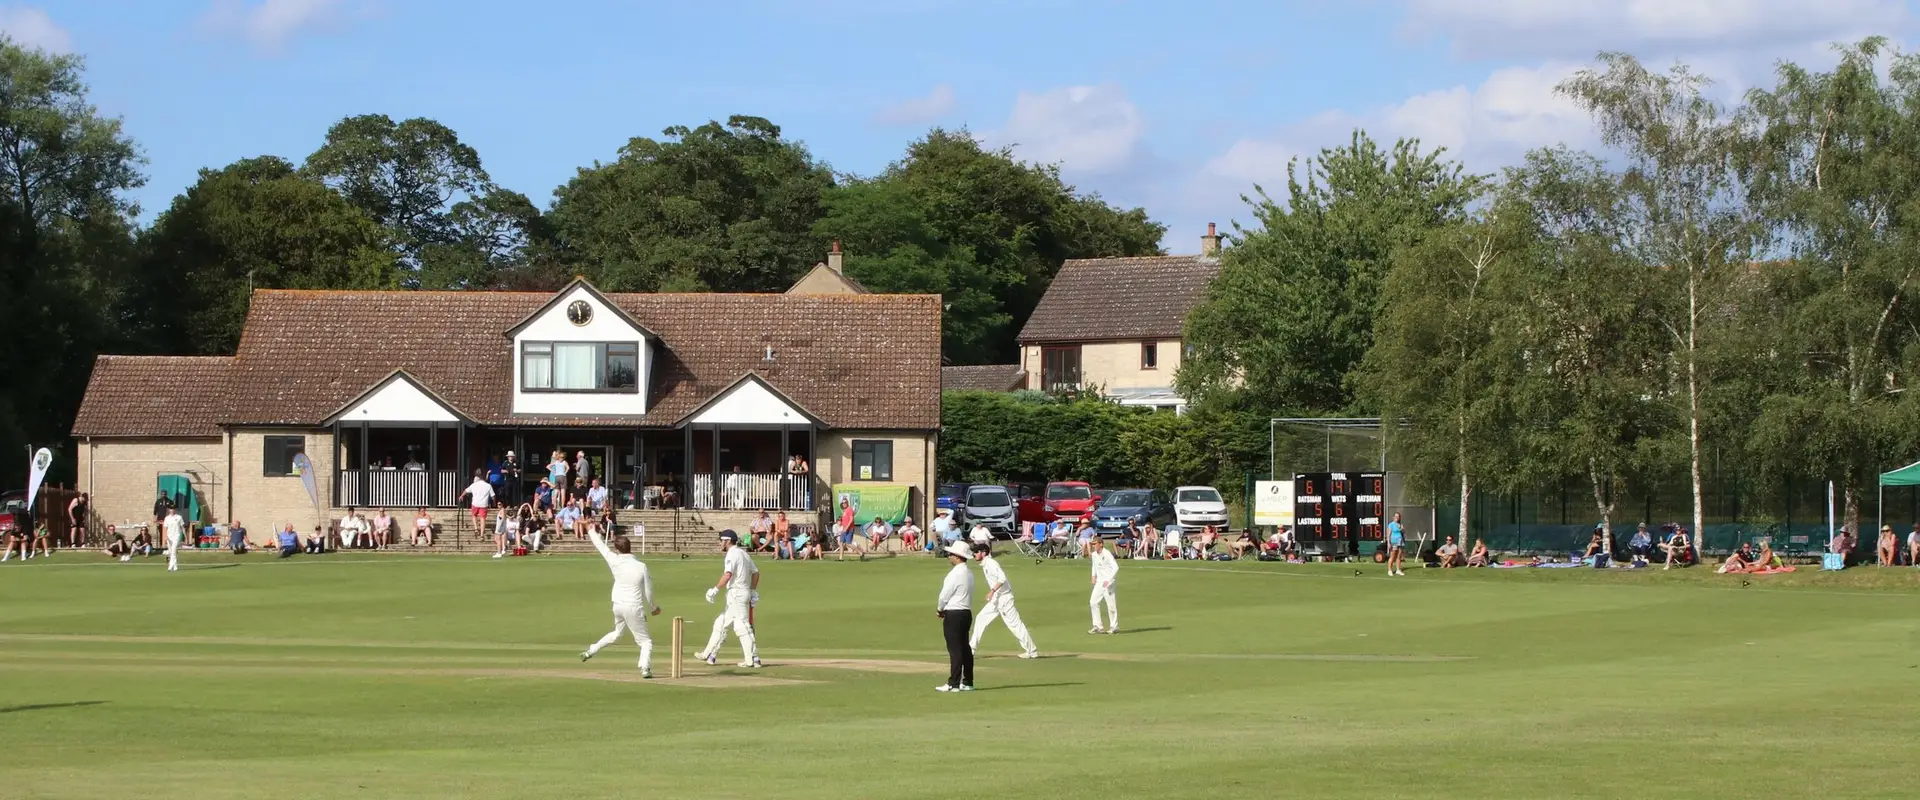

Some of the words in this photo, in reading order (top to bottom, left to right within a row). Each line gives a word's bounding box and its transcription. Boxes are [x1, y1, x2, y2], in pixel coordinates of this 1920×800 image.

[1306, 480, 1313, 494] 6
[1374, 480, 1381, 494] 8
[1298, 495, 1321, 503] BATSMAN
[1331, 495, 1347, 503] WKTS
[1357, 495, 1381, 503] BATSMAN
[1315, 503, 1322, 516] 5
[1335, 503, 1342, 516] 6
[1374, 503, 1381, 516] 0
[1298, 517, 1322, 525] LASTMAN
[1330, 517, 1348, 525] OVERS
[1315, 525, 1322, 537] 4
